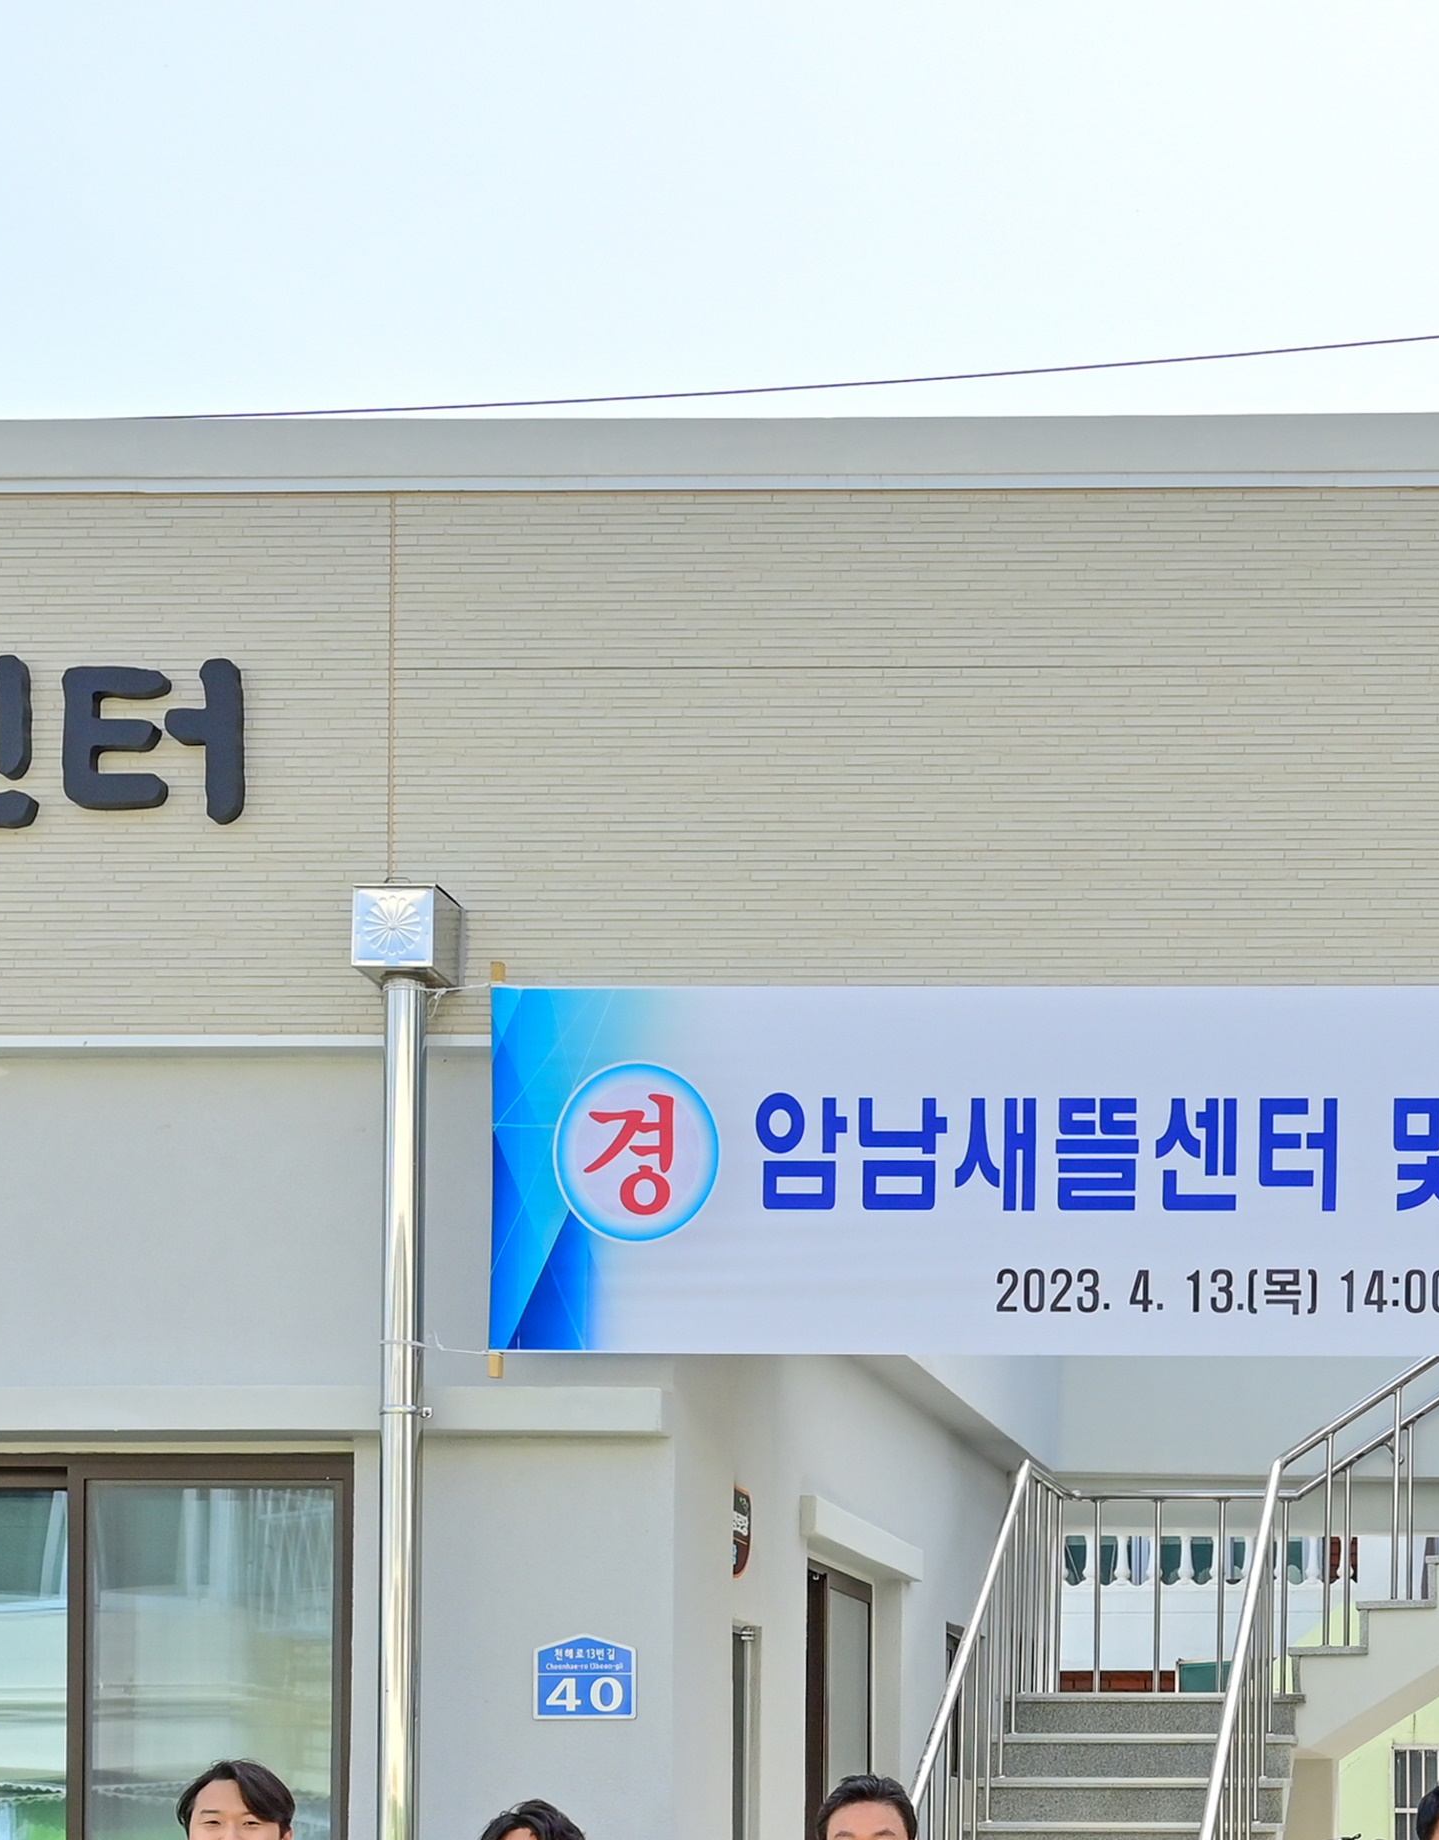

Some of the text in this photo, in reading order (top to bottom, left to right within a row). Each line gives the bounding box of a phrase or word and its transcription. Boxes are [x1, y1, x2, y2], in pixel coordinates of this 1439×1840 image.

[583, 1092, 677, 1216] 경
[755, 1091, 1339, 1212] 암남새뜰센터
[996, 1268, 1111, 1314] 2023.
[1129, 1269, 1164, 1313] 4.
[1186, 1268, 1318, 1316] 13.(목)
[545, 1676, 624, 1712] 40
